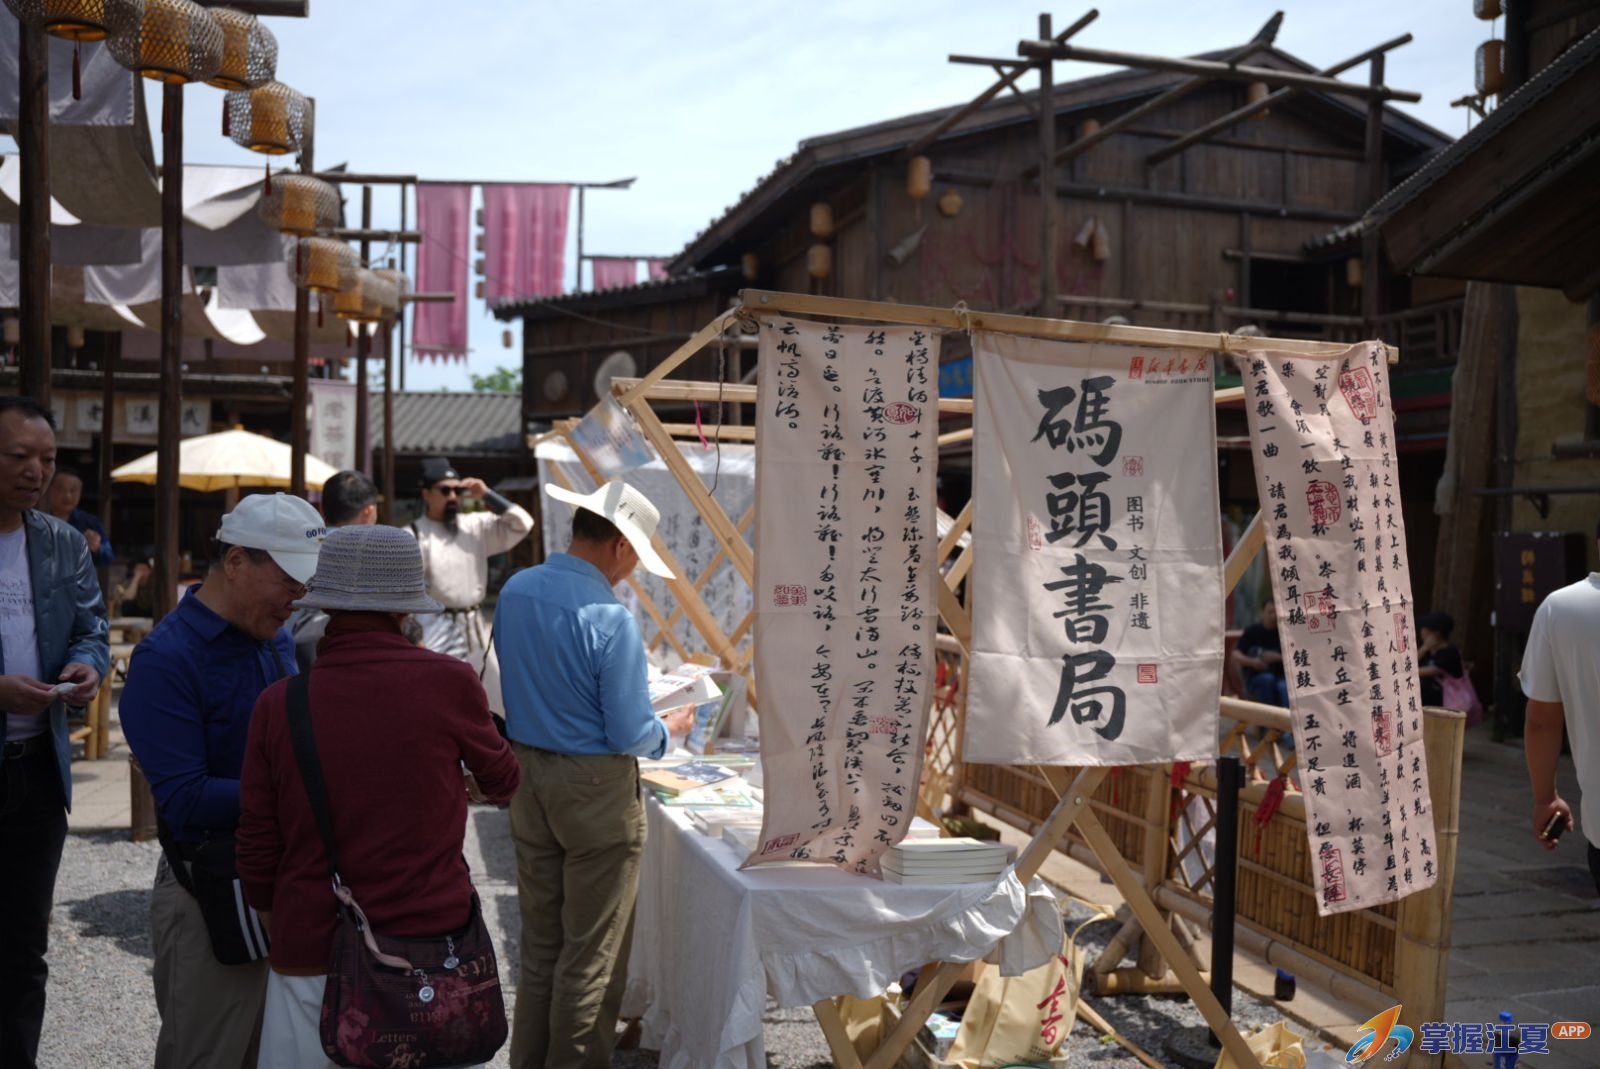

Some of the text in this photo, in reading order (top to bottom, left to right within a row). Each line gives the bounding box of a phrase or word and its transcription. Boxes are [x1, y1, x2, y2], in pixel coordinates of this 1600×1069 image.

[1126, 494, 1145, 532] 图书
[1030, 375, 1127, 742] 碼頭書局
[1128, 544, 1148, 581] 文创
[1129, 592, 1152, 630] 非遗
